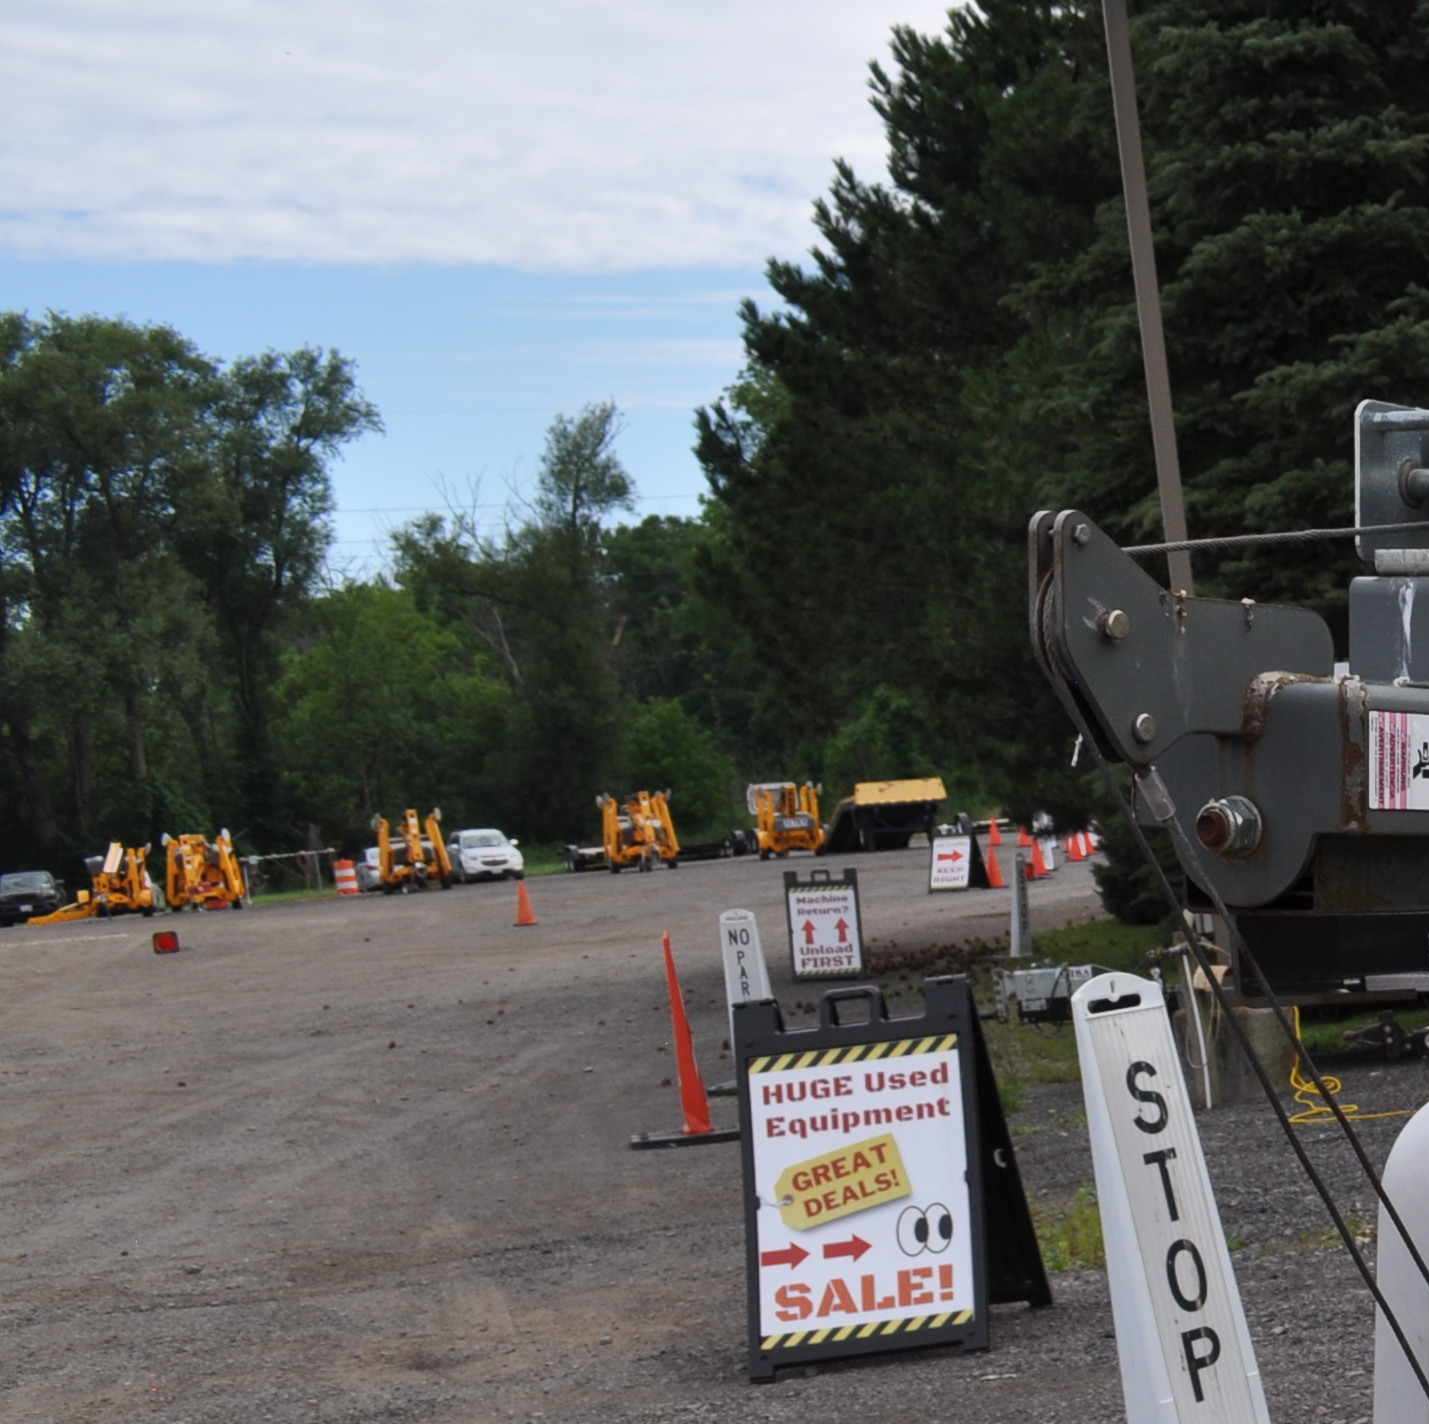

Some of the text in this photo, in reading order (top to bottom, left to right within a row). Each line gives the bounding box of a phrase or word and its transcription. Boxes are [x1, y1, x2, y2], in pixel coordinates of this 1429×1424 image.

[933, 875, 965, 883] RIGHT
[796, 895, 848, 904] Machine
[797, 906, 848, 916] Return?
[728, 928, 750, 946] NO
[800, 943, 853, 955] Unload
[801, 955, 854, 968] FIRST
[762, 1062, 948, 1105] HUGE Used
[766, 1097, 950, 1138] Equipment
[792, 1143, 887, 1192] GREAT
[803, 1169, 900, 1217] DEALS!
[1126, 1060, 1221, 1402] STOP
[775, 1264, 953, 1322] SALE!
